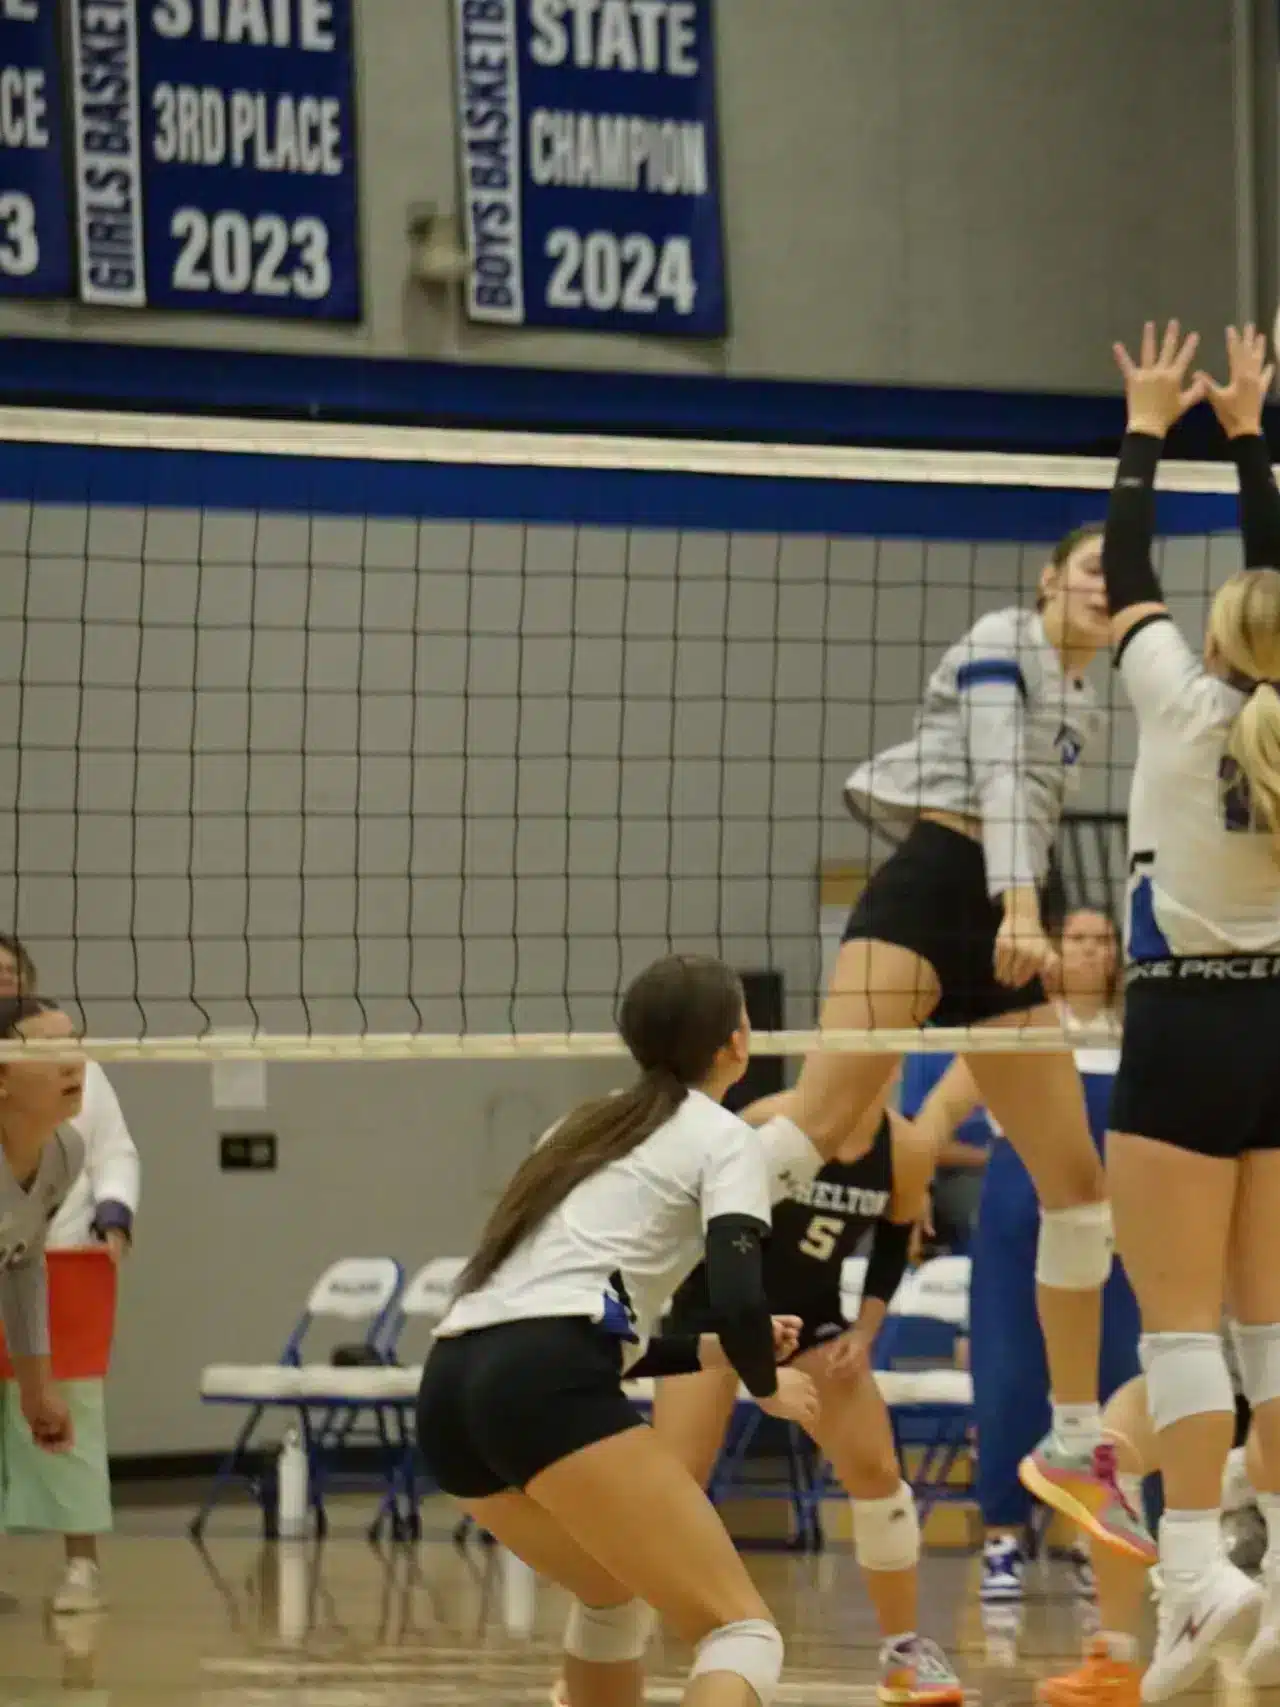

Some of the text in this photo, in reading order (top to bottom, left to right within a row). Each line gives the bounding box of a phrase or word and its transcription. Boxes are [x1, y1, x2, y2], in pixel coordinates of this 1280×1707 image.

[528, 0, 699, 77] STATE
[152, 81, 343, 176] 3RD PLACE
[528, 106, 708, 195] CHAMPION
[84, 165, 136, 291] GIRLS
[169, 205, 333, 300] 2023
[473, 199, 513, 310] BOYS
[544, 226, 698, 316] 2024
[798, 1214, 847, 1262] 5
